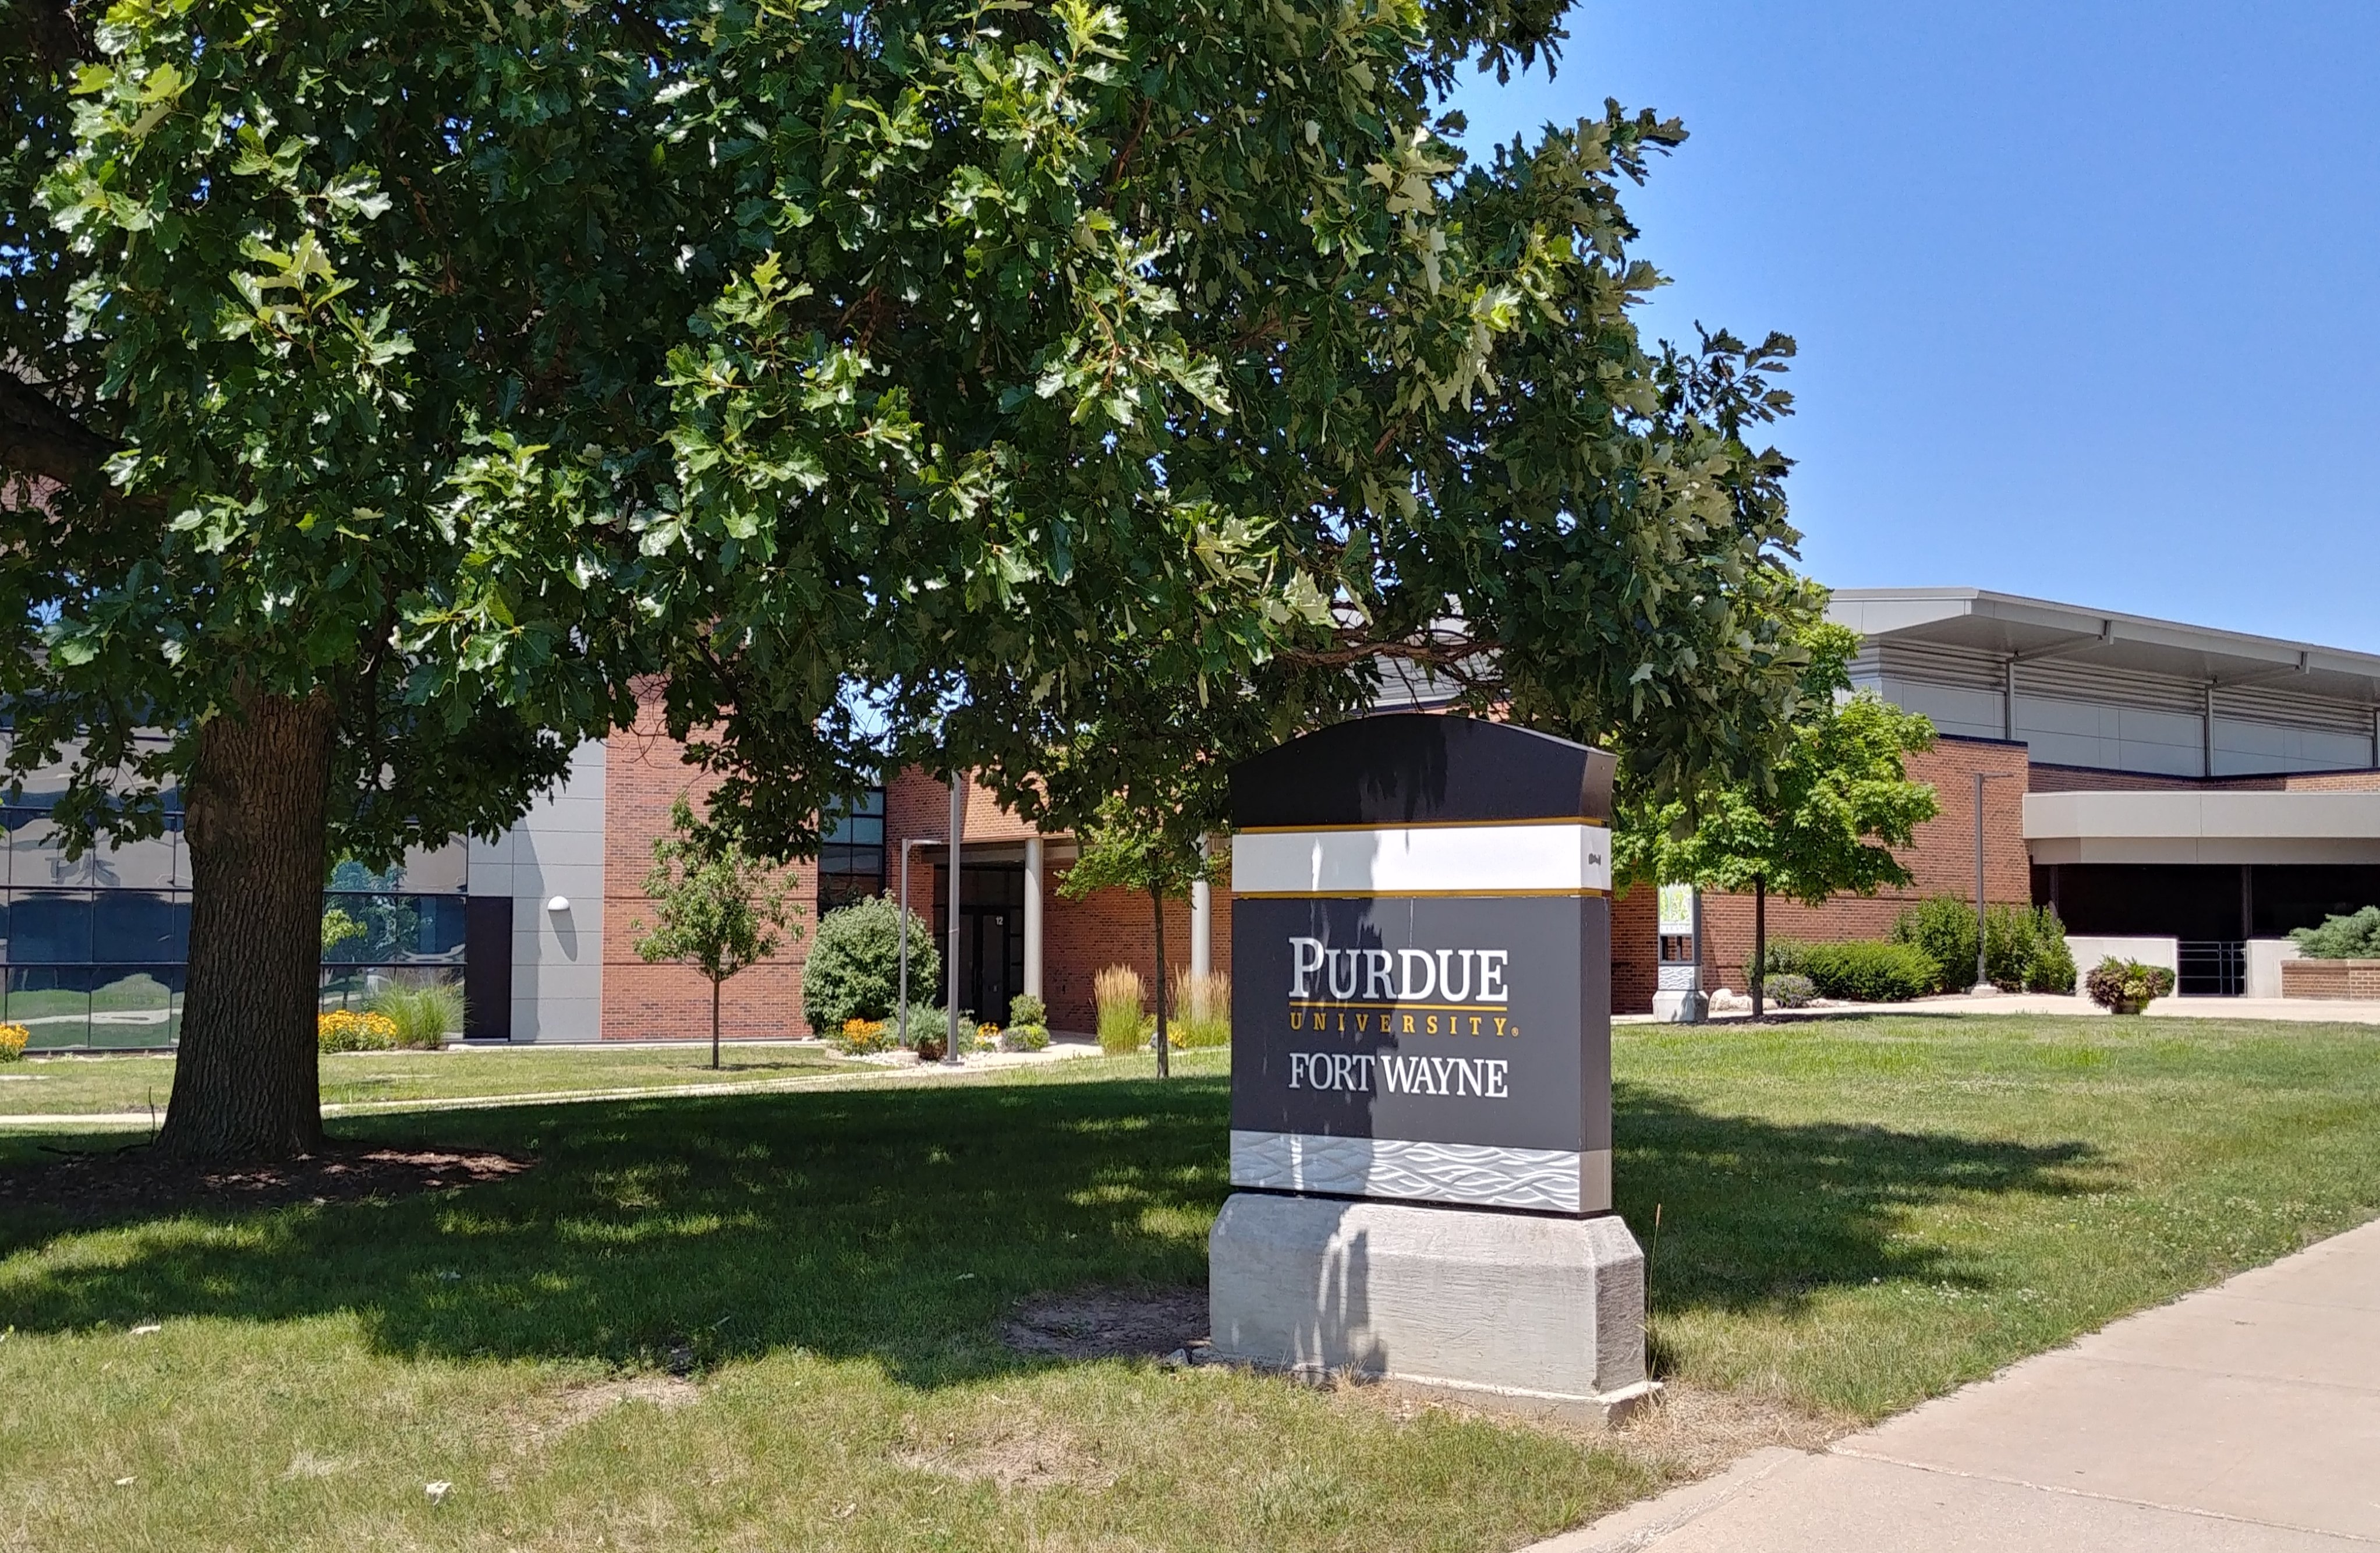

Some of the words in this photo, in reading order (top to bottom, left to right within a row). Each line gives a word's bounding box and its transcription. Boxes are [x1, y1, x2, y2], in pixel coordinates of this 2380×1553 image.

[996, 916, 1003, 925] 12
[1288, 937, 1508, 1002] PURDUE
[1288, 1053, 1375, 1091] FORT
[1380, 1055, 1508, 1098] WAYNE
